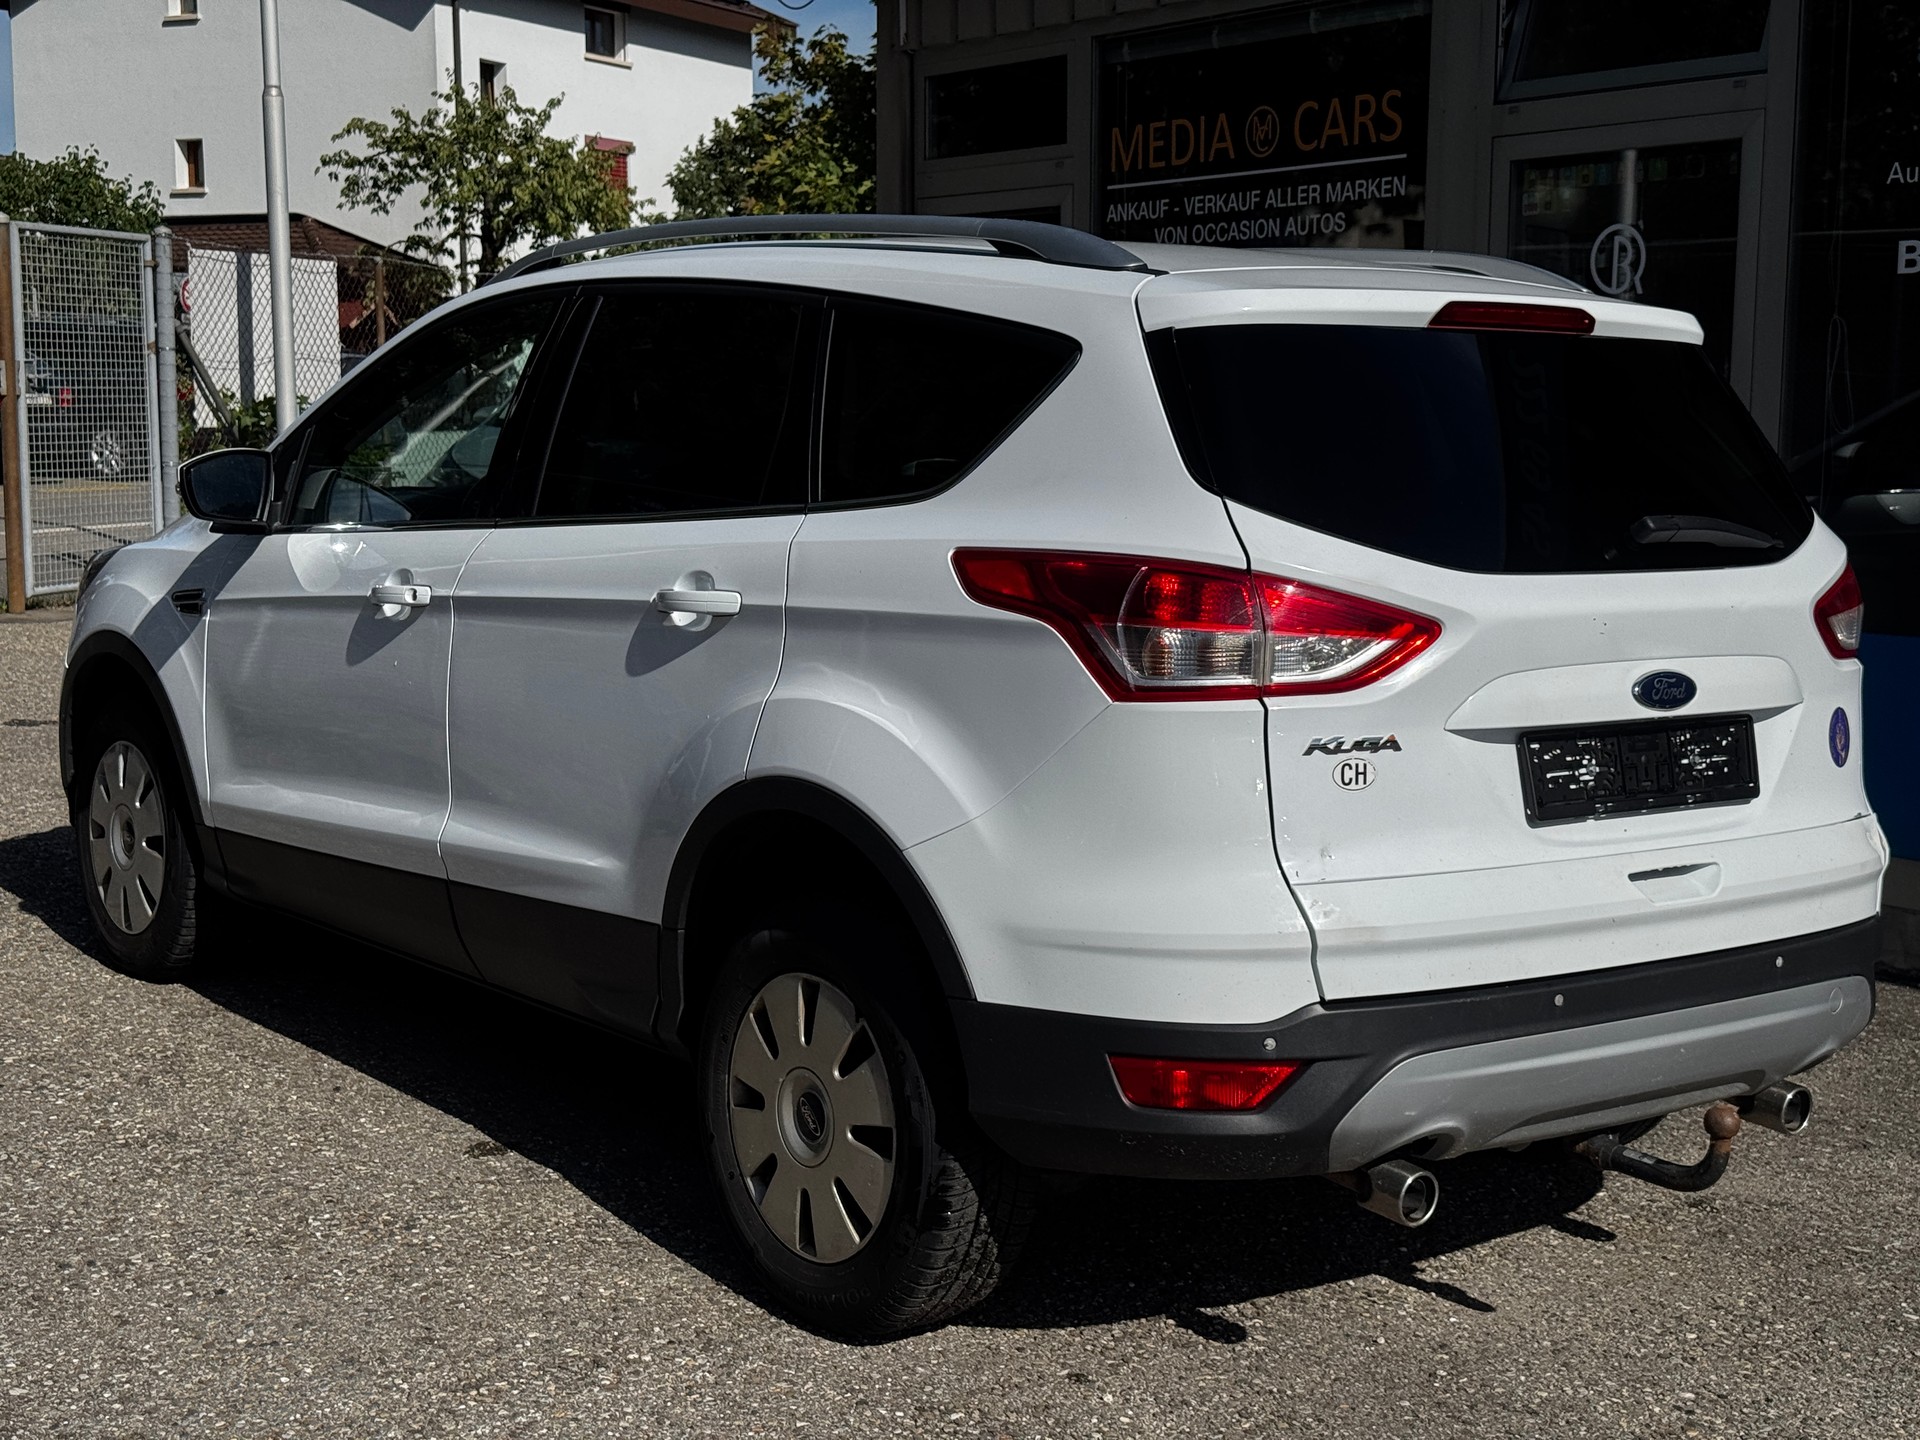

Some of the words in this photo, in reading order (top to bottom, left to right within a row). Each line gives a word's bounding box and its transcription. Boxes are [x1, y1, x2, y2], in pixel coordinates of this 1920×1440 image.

[1110, 112, 1235, 173] MEDIA
[1294, 89, 1403, 151] CARS
[1106, 199, 1170, 223] ANKAUF
[1184, 190, 1261, 216] VERKAUF
[1264, 183, 1325, 209] ALLER
[1326, 175, 1407, 203] MARKEN
[1154, 225, 1188, 245] VON
[1192, 217, 1281, 243] OCCASION
[1284, 212, 1347, 237] AUTOS
[1651, 677, 1687, 700] Ford
[1302, 734, 1402, 756] KUGA
[1340, 762, 1367, 786] CH
